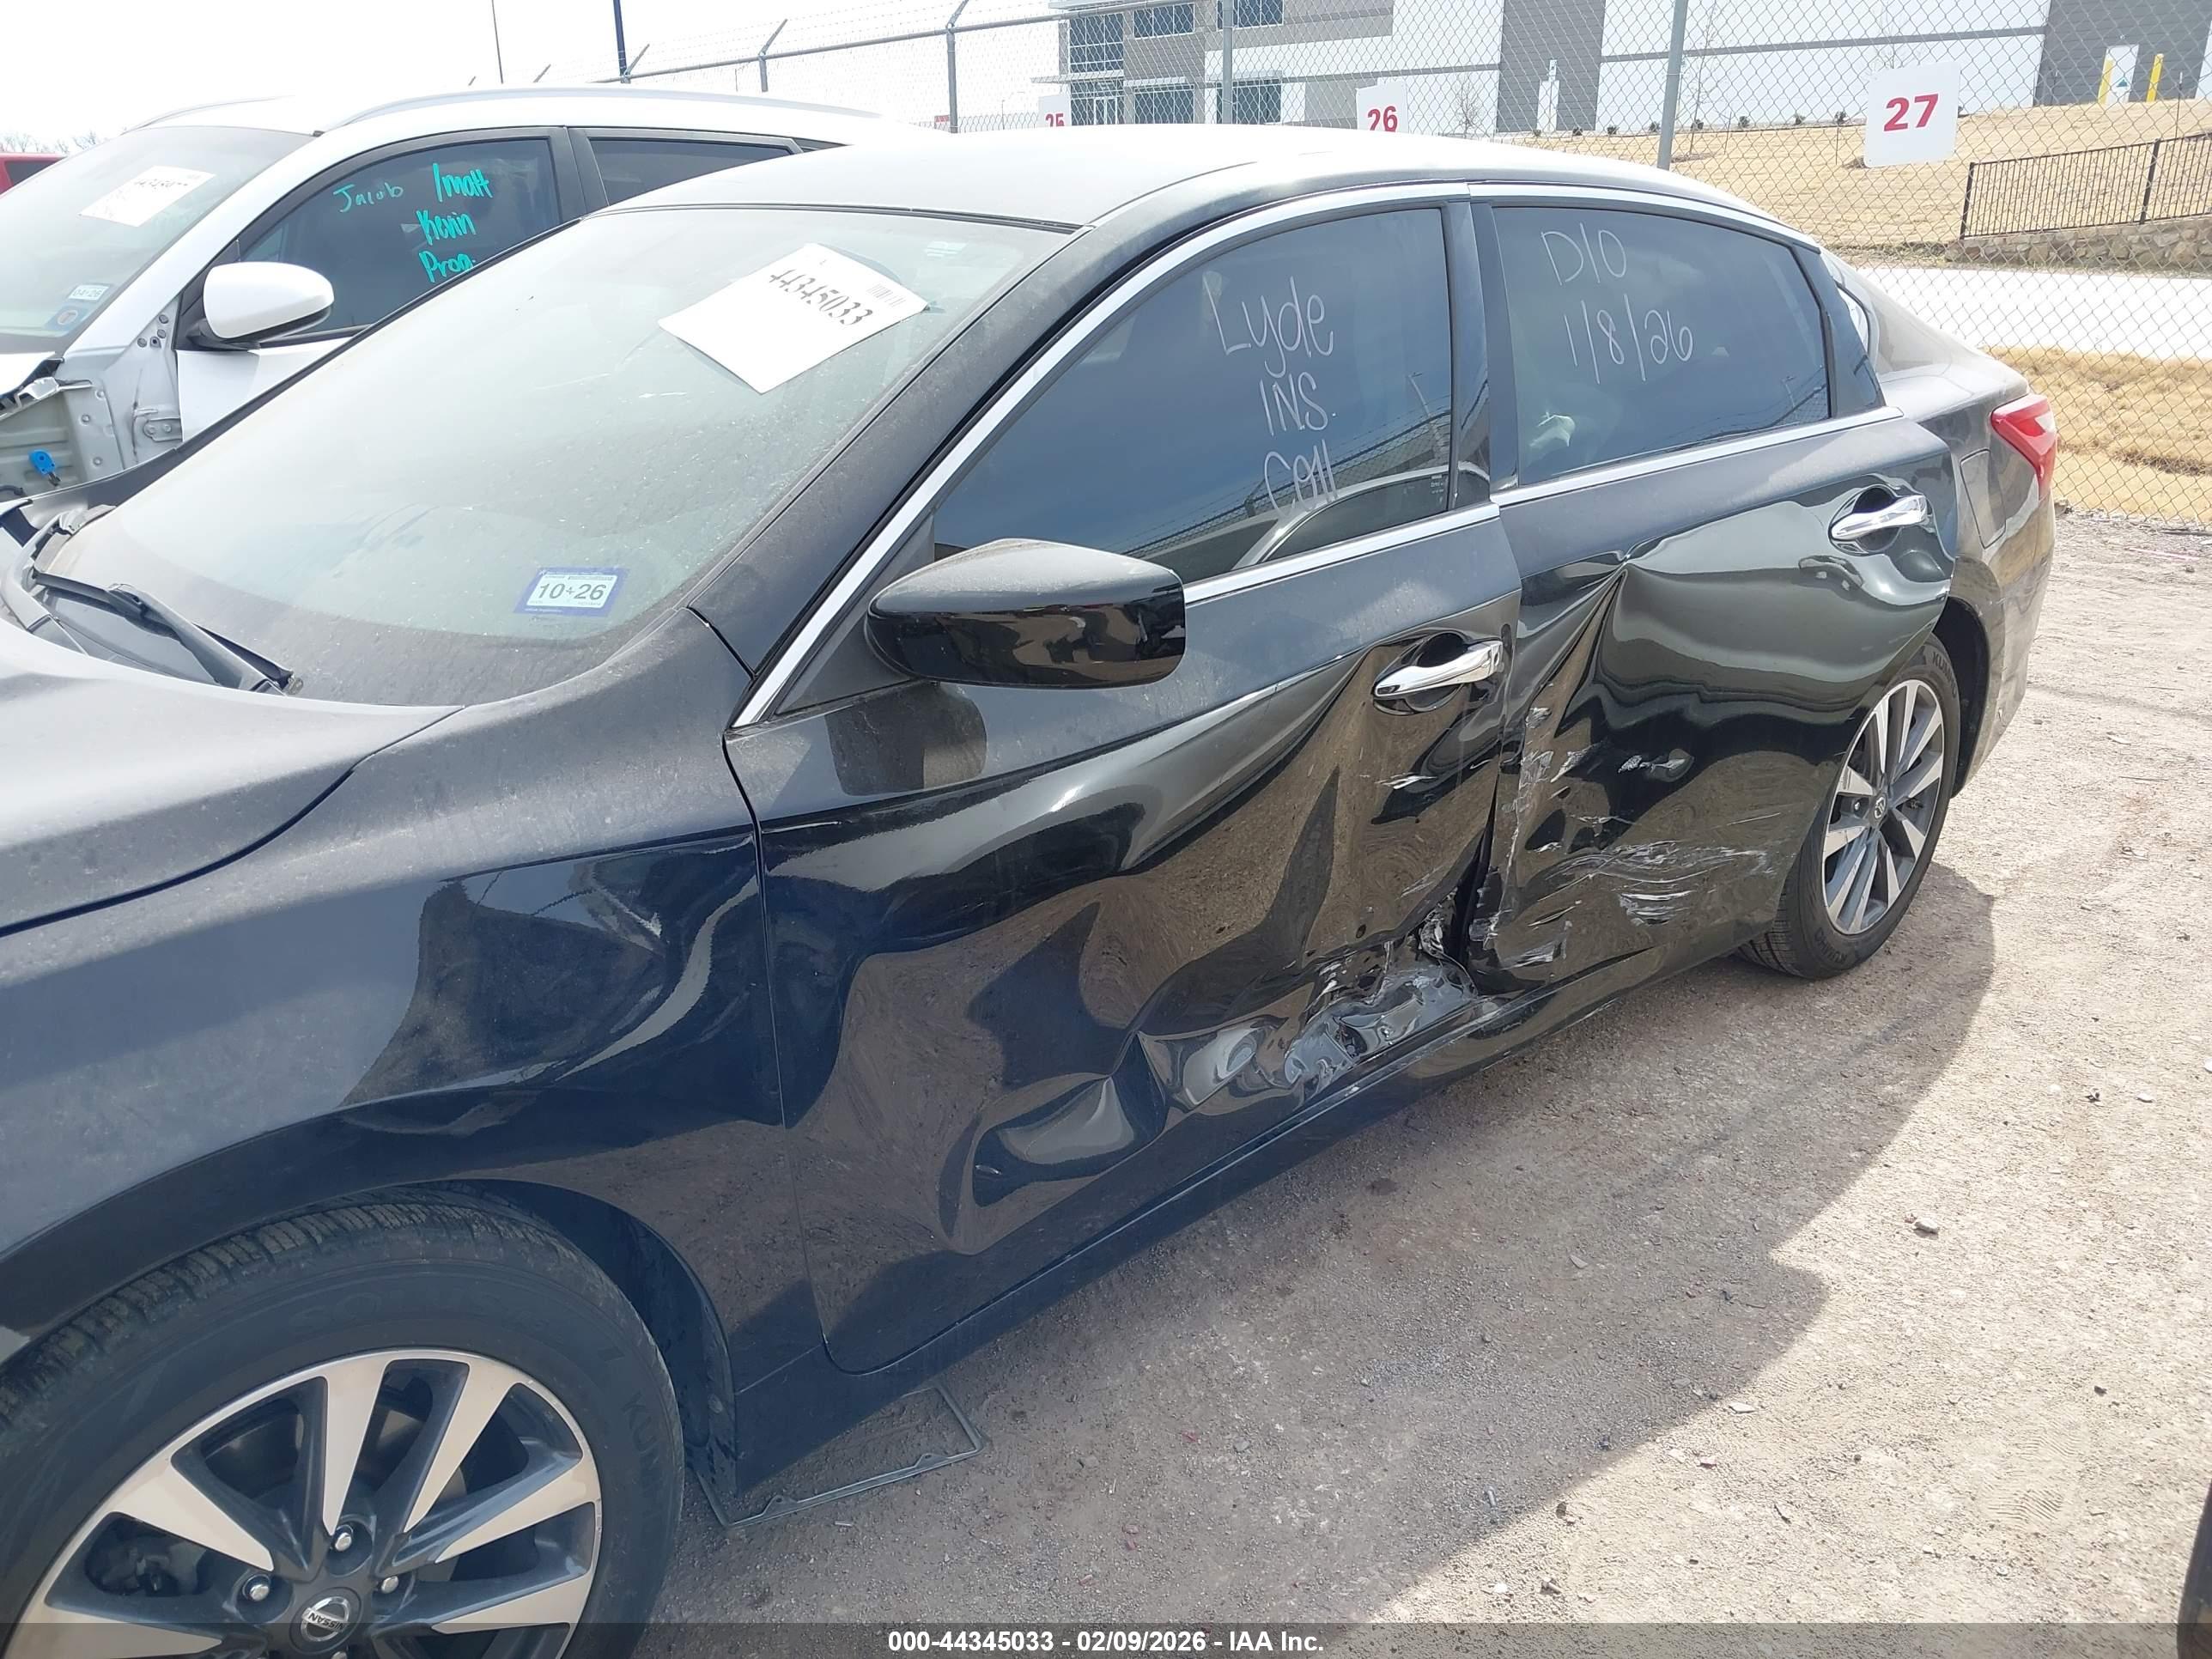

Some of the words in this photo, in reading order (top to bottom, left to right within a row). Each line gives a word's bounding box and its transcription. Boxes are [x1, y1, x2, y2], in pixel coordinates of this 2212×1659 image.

[1045, 112, 1065, 127] 25
[1367, 105, 1398, 132] 26
[1883, 93, 1939, 132] 27
[416, 209, 477, 246] Kevin
[769, 268, 874, 326] 44345033
[1203, 276, 1334, 379] Lyde
[1563, 292, 1694, 385] 1/8/26
[1259, 371, 1337, 437] INS.
[307, 1612, 345, 1631] NISSAN
